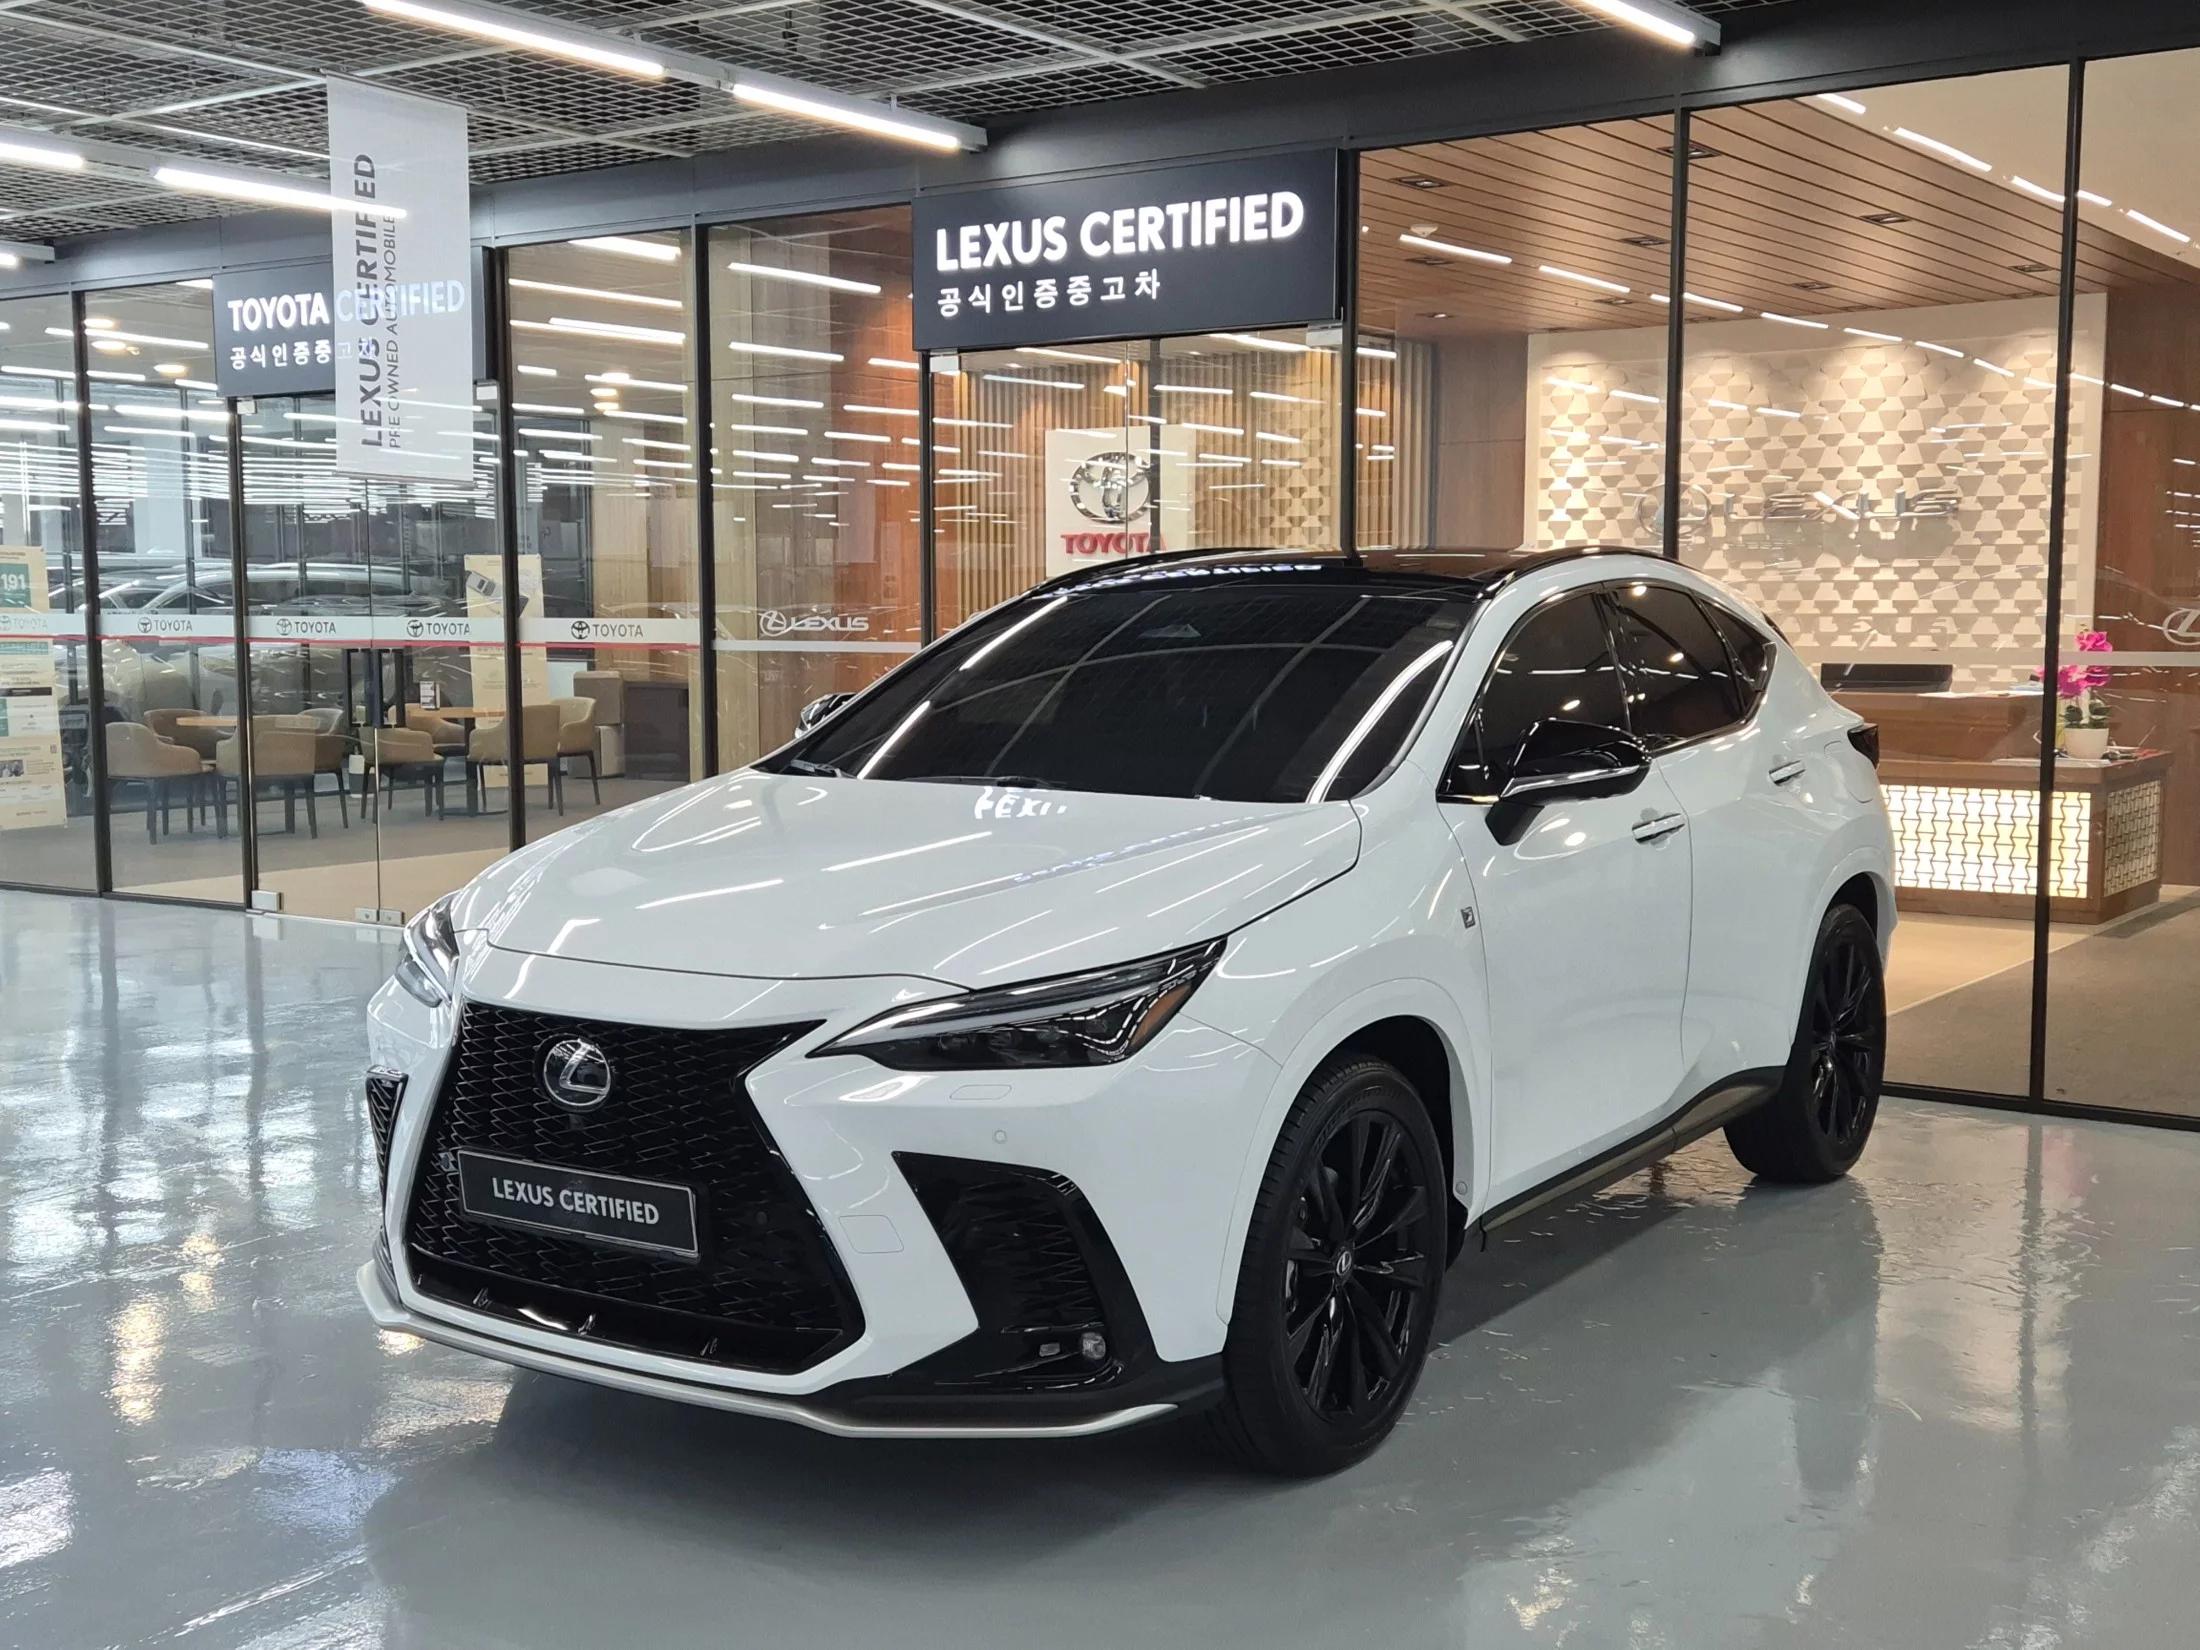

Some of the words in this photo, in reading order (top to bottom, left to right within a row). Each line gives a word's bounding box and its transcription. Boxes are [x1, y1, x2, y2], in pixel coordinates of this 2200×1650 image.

[354, 154, 378, 326] CERTIFED
[936, 215, 1068, 272] LEXUS
[1079, 190, 1304, 257] CERTIFIED
[227, 292, 331, 332] TOYOTA
[357, 337, 383, 447] LEXUS
[386, 340, 399, 411] OWNED
[154, 619, 192, 632] TOYOTA
[294, 621, 336, 634] TOYOTA
[427, 622, 471, 635] TOYOTA
[593, 624, 643, 637] TOYOTA
[791, 616, 869, 632] LEXUS
[492, 1177, 554, 1208] LEXUS
[559, 1189, 660, 1225] CERTIFIED
